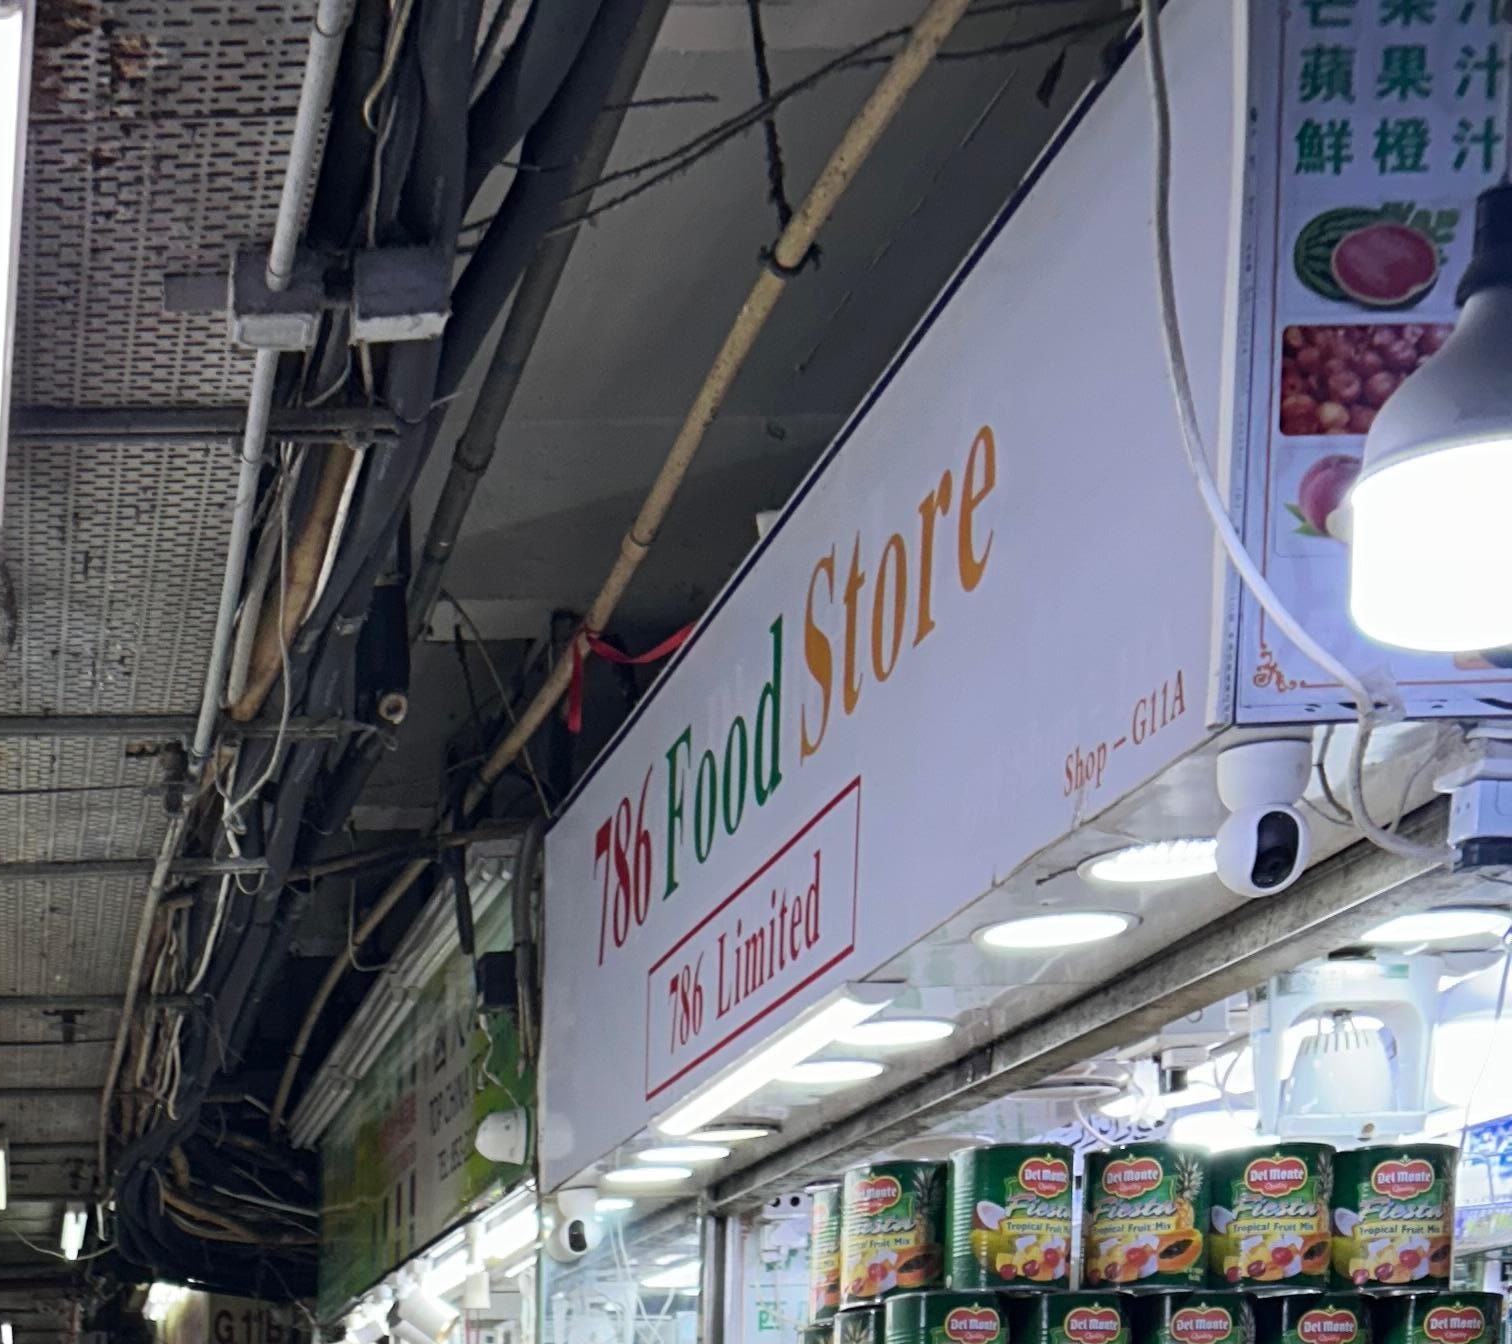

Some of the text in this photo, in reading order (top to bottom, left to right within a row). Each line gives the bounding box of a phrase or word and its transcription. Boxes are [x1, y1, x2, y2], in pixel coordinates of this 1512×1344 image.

[594, 425, 997, 966] 786 Food Store
[1063, 670, 1186, 797] Shop G11A
[668, 850, 821, 1053] 786 Limited
